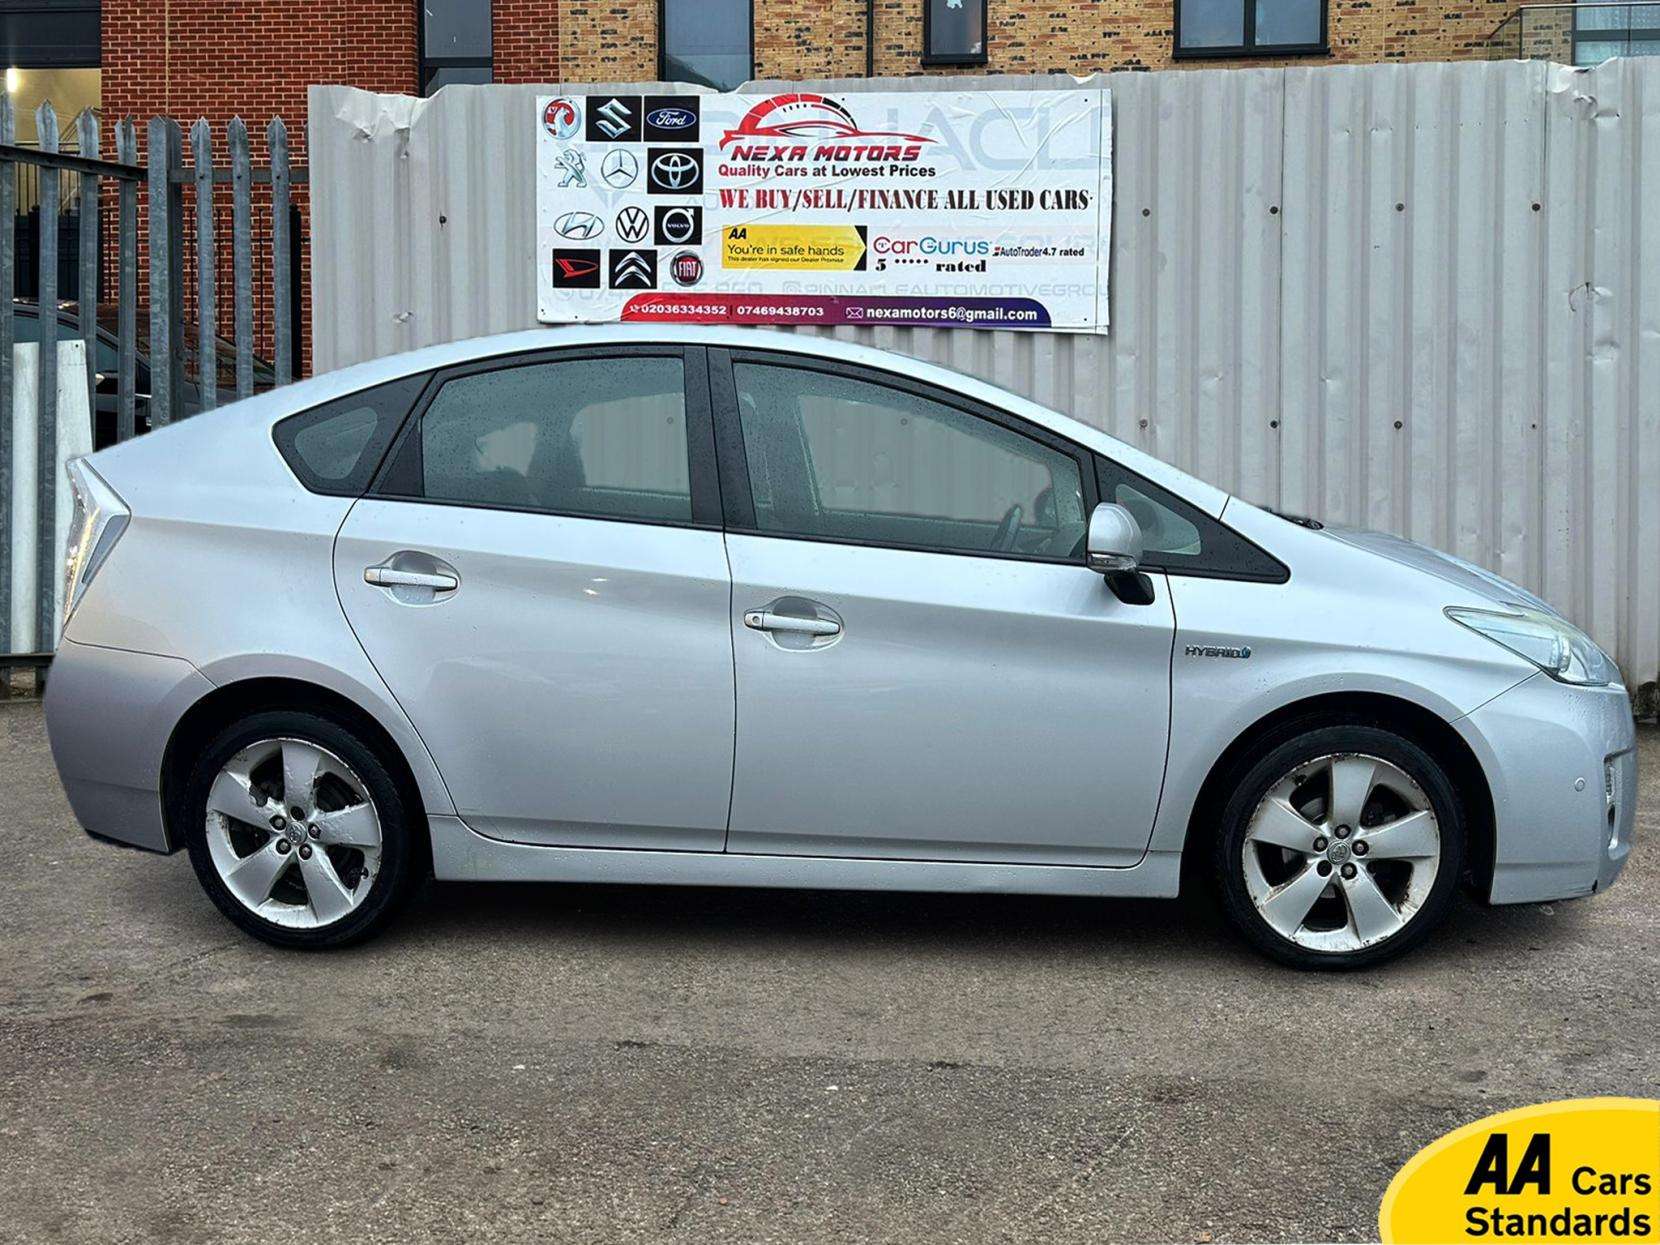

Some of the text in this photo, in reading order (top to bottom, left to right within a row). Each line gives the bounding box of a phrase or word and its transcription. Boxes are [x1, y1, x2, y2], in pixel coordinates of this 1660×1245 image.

[656, 111, 687, 126] Ford
[731, 145, 922, 162] NEXA MOTORS
[718, 164, 936, 179] Quality Cars at Lowest Prices
[719, 189, 749, 209] WE
[944, 189, 980, 210] ALL
[985, 189, 1035, 211] USED
[728, 228, 747, 239] AA
[727, 244, 845, 256] You're in safe hands
[1059, 247, 1085, 256] rated
[678, 261, 698, 278] FIAT
[875, 258, 987, 273] 5 rated
[641, 304, 825, 317] 02036334352 07469438703
[866, 306, 1038, 322] nexamotors6@gmail.com
[1185, 644, 1241, 659] HYBRID
